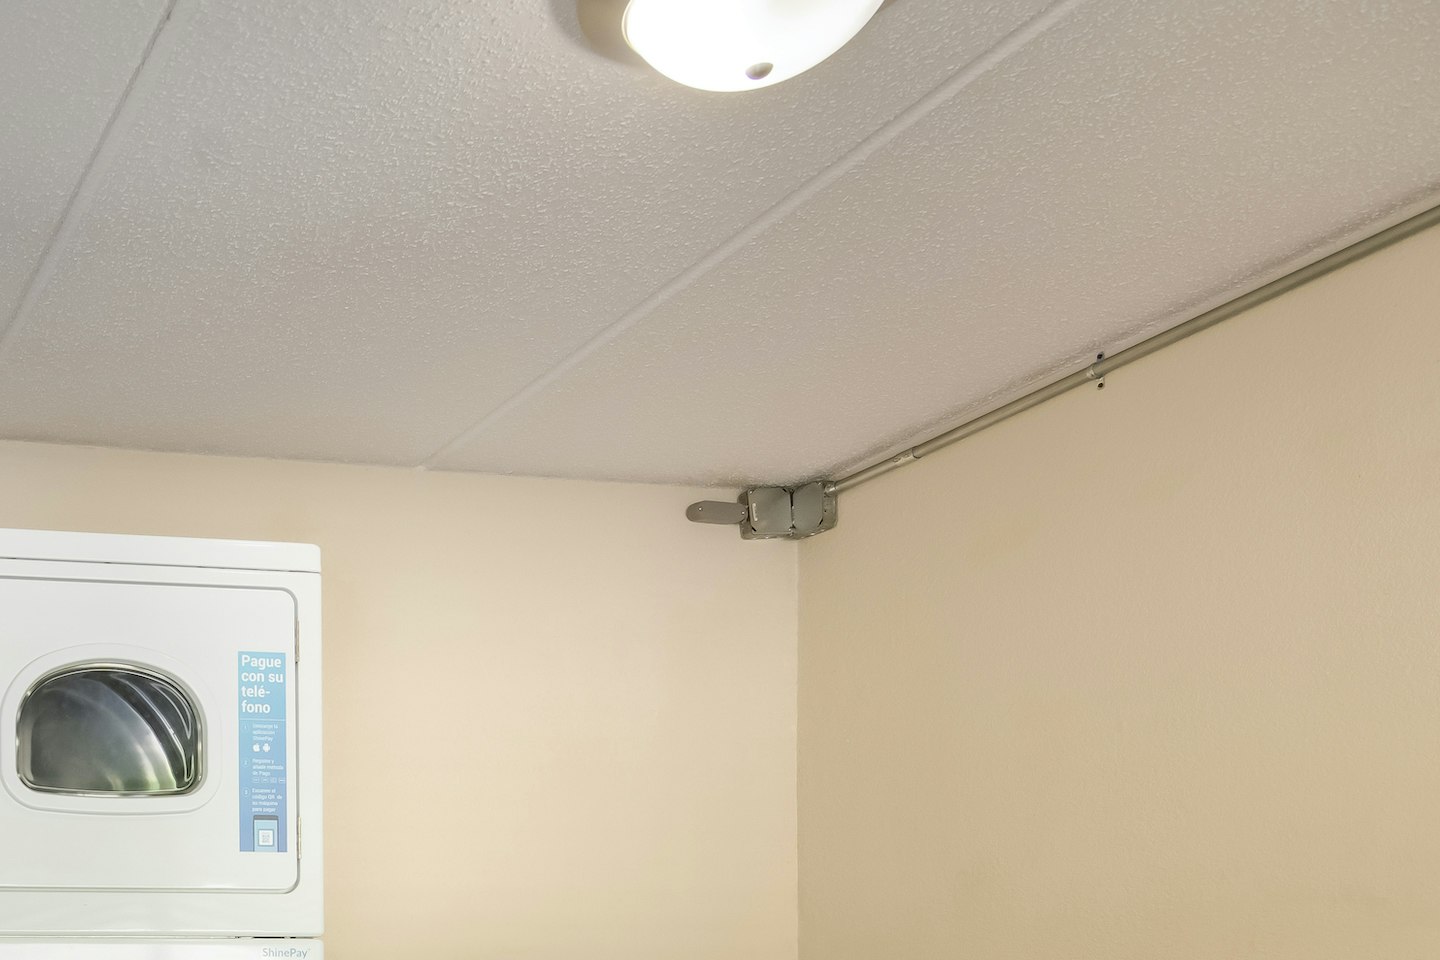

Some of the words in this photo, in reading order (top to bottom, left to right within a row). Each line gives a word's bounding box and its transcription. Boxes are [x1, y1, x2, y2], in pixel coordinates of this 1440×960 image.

[241, 655, 282, 670] Pague
[241, 672, 265, 682] con
[268, 673, 284, 683] su
[241, 685, 271, 698] telé-
[241, 700, 271, 714] fono
[262, 947, 308, 959] ShinePay
